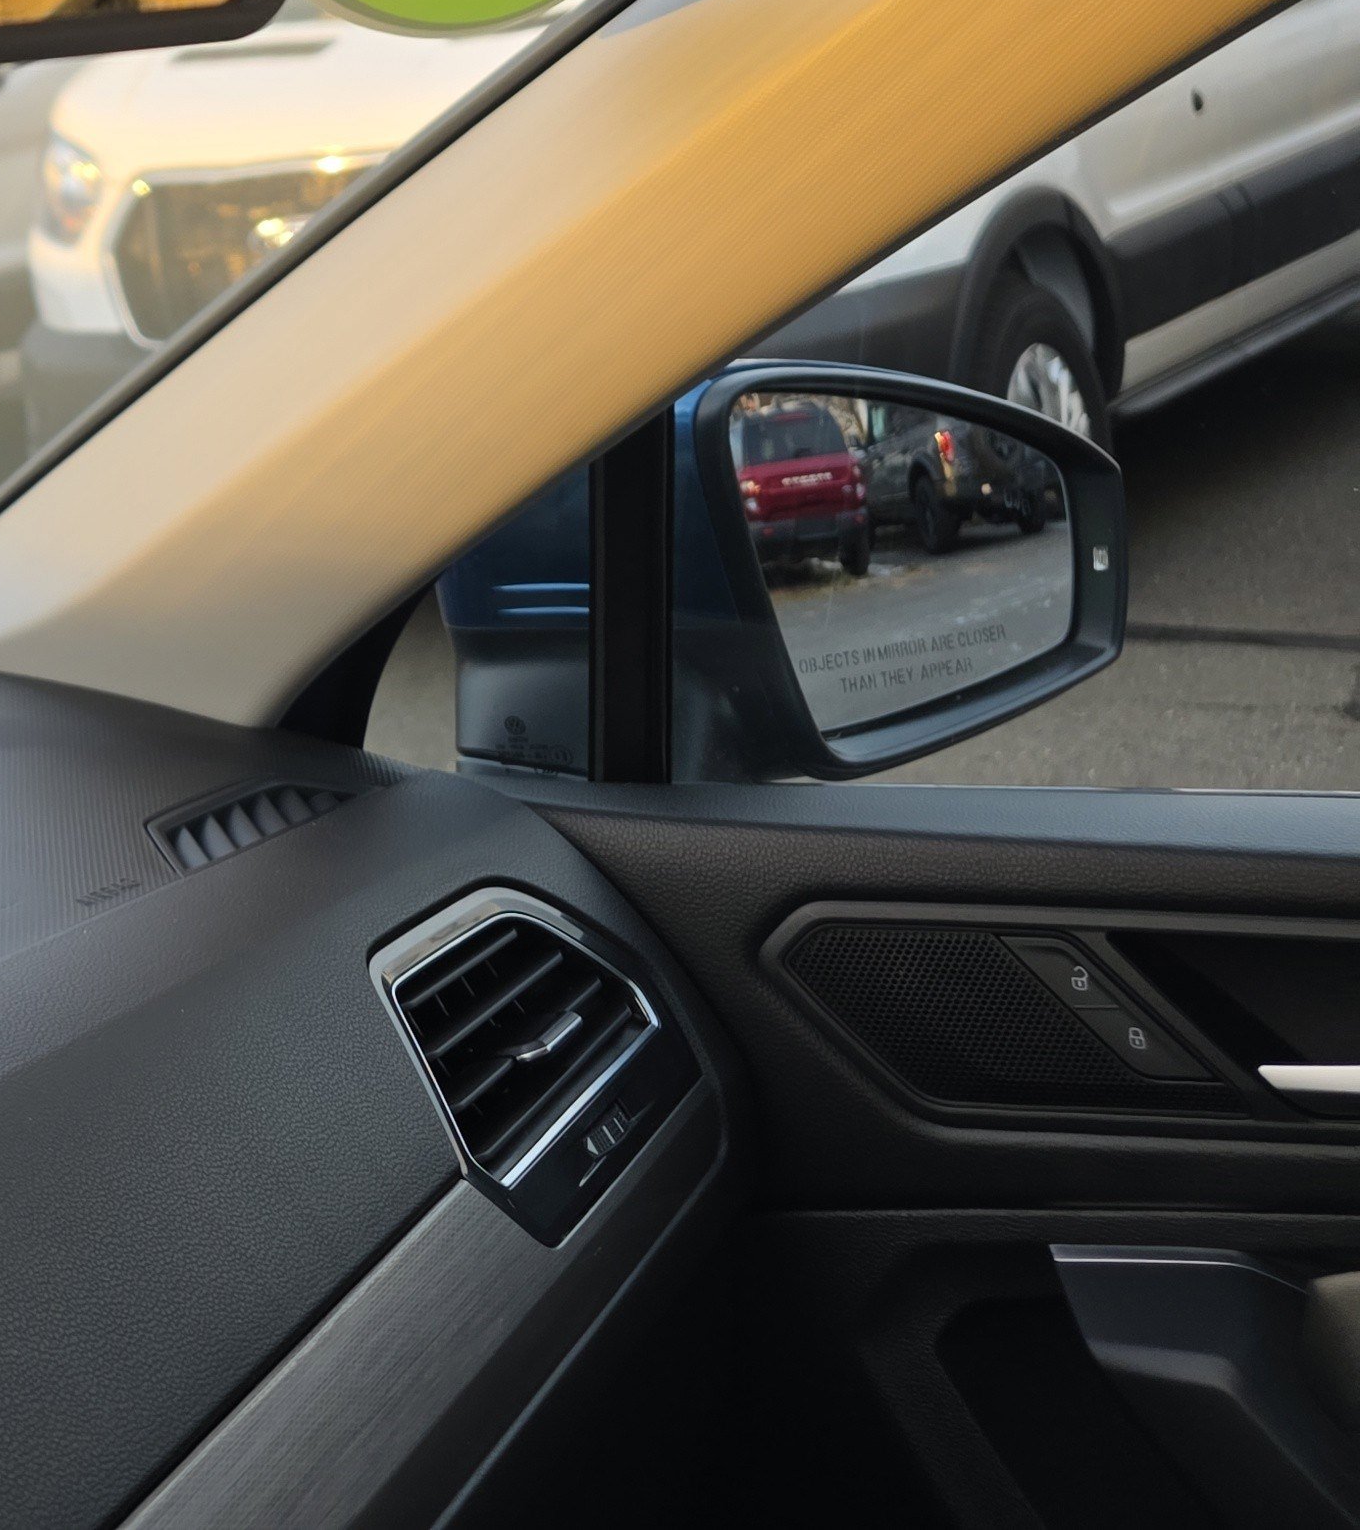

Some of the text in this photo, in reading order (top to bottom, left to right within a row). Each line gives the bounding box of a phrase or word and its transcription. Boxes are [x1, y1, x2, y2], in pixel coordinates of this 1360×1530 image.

[799, 624, 1007, 673] OBJECTS IN MIRROR ARE CLOSER
[840, 657, 974, 694] THAN THEY APPEAR
